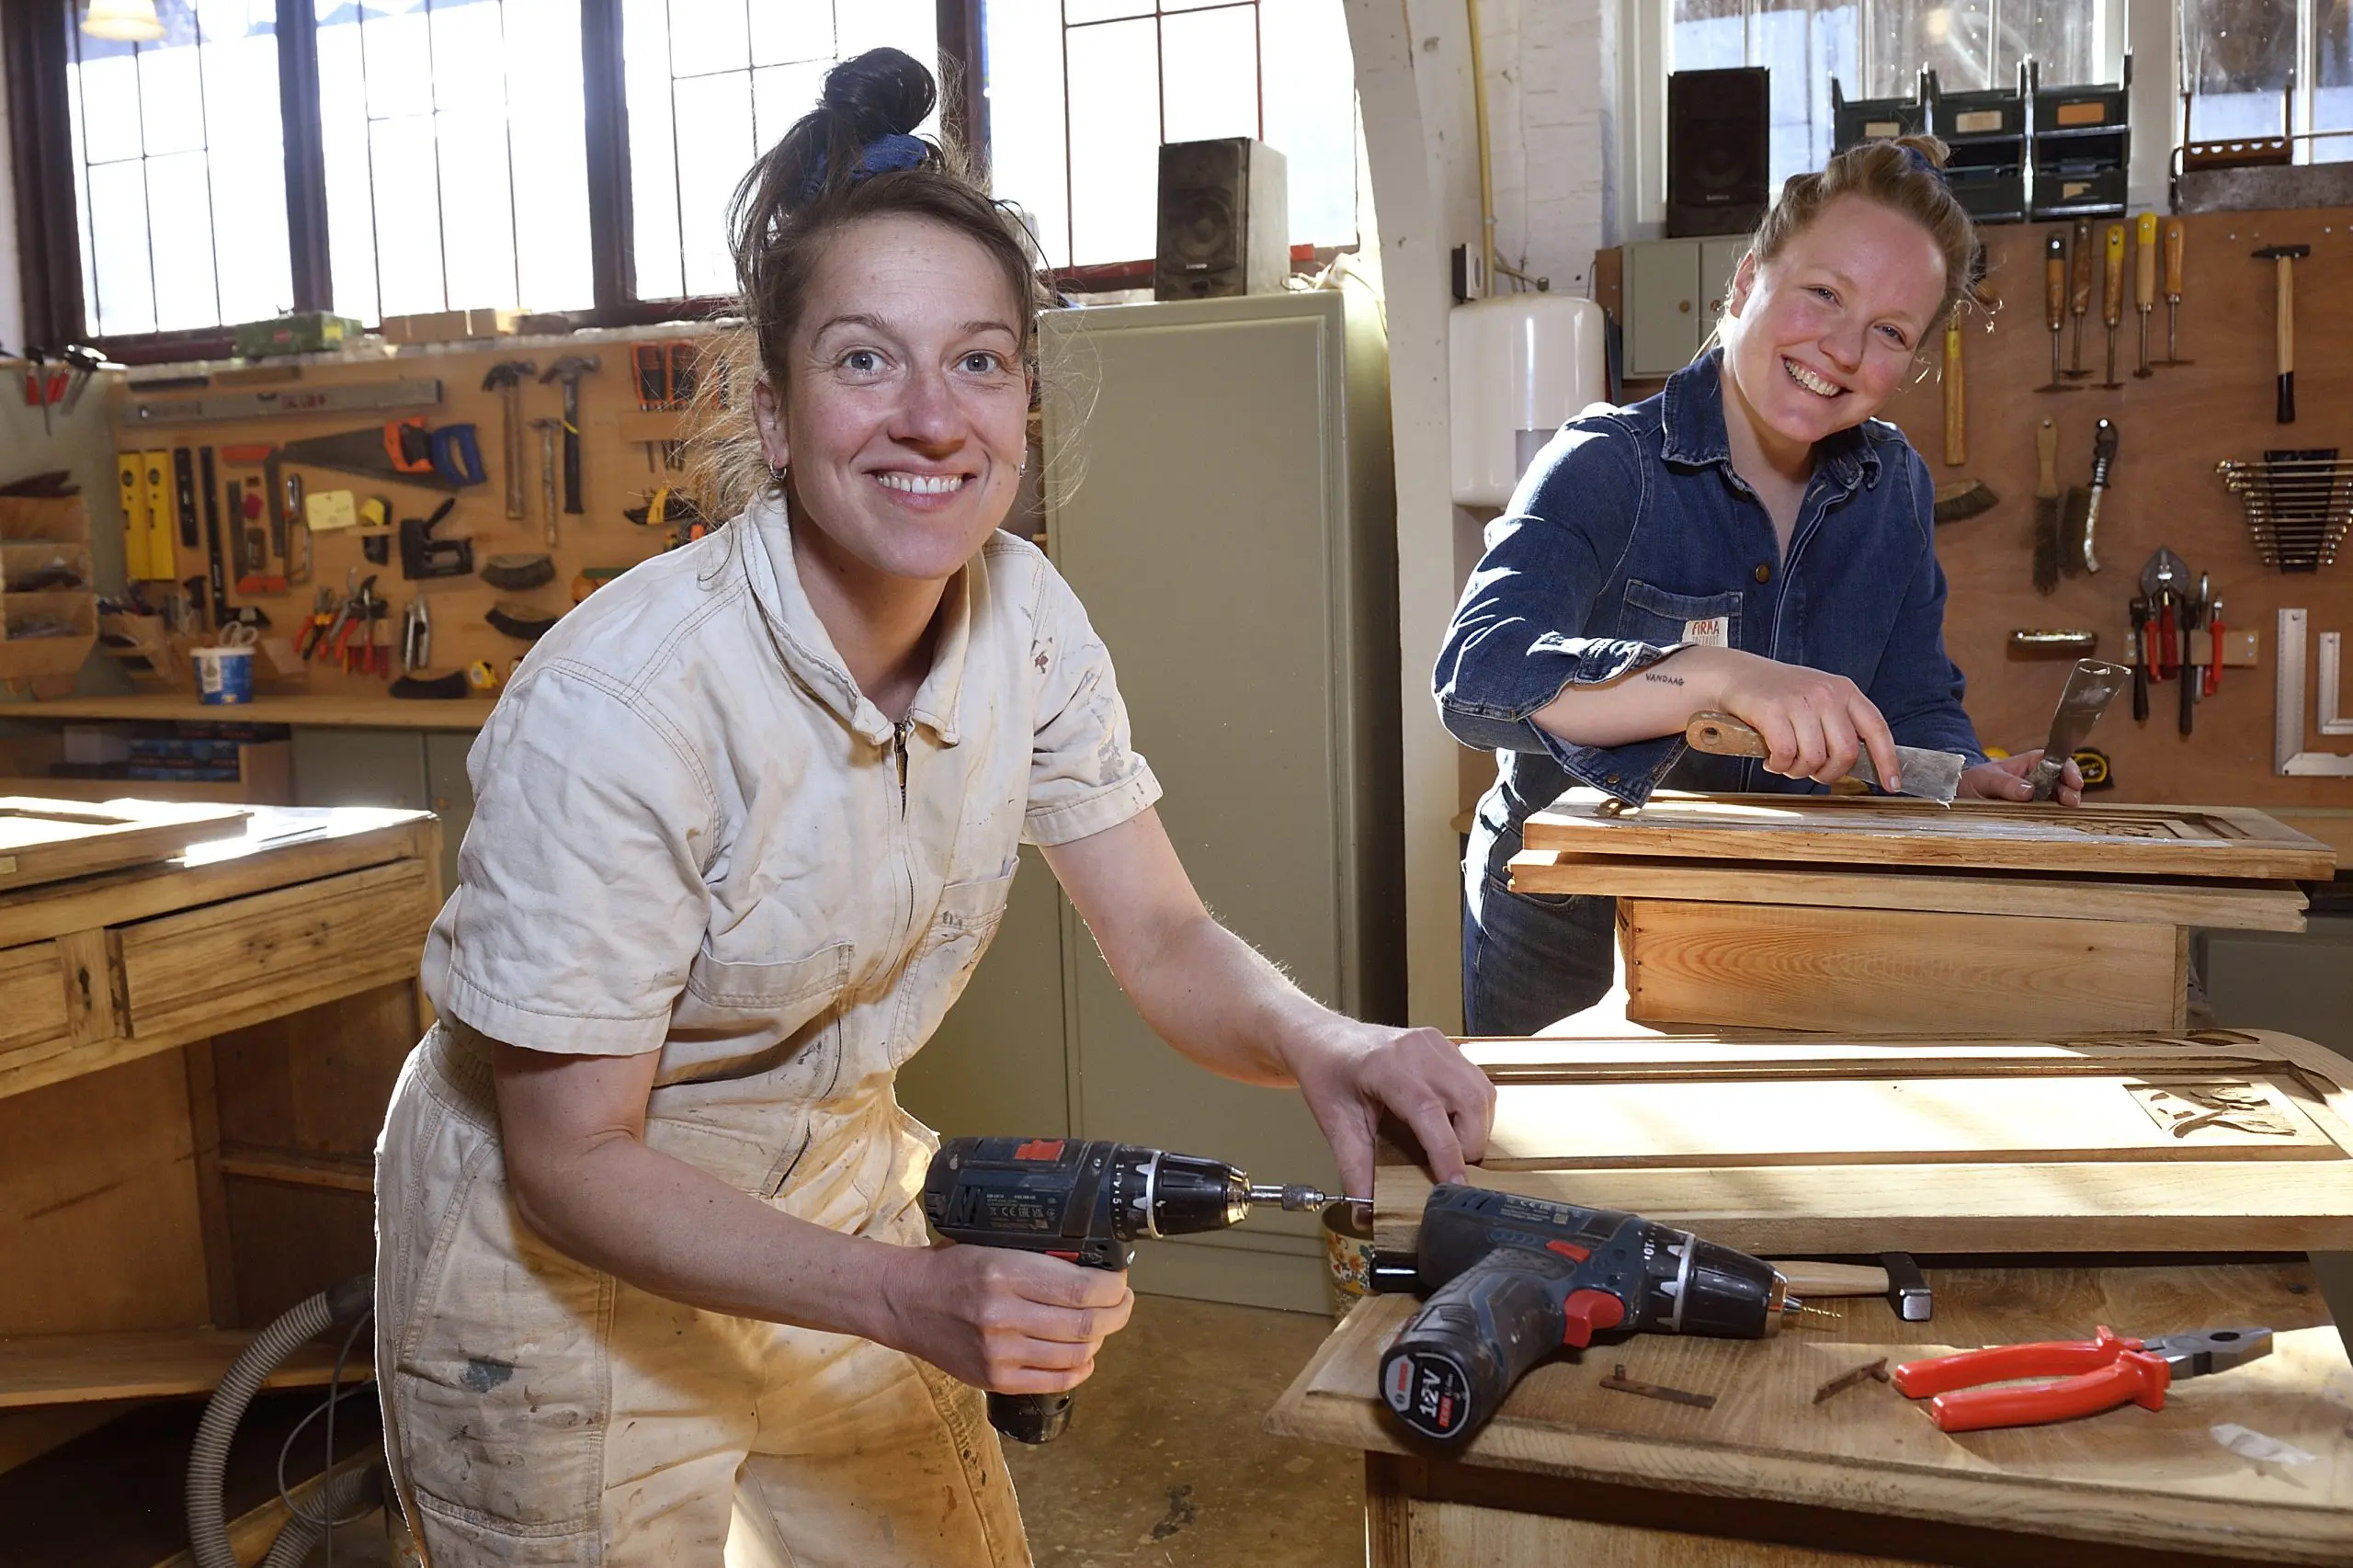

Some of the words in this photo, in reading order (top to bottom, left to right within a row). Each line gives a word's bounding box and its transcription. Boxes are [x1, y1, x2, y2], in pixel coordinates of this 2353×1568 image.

[1692, 620, 1720, 635] FIRMA
[1645, 673, 1685, 687] VANDAAG
[1112, 1197, 1122, 1205] 5
[1643, 1242, 1655, 1256] 10
[1419, 1368, 1441, 1417] 12V
